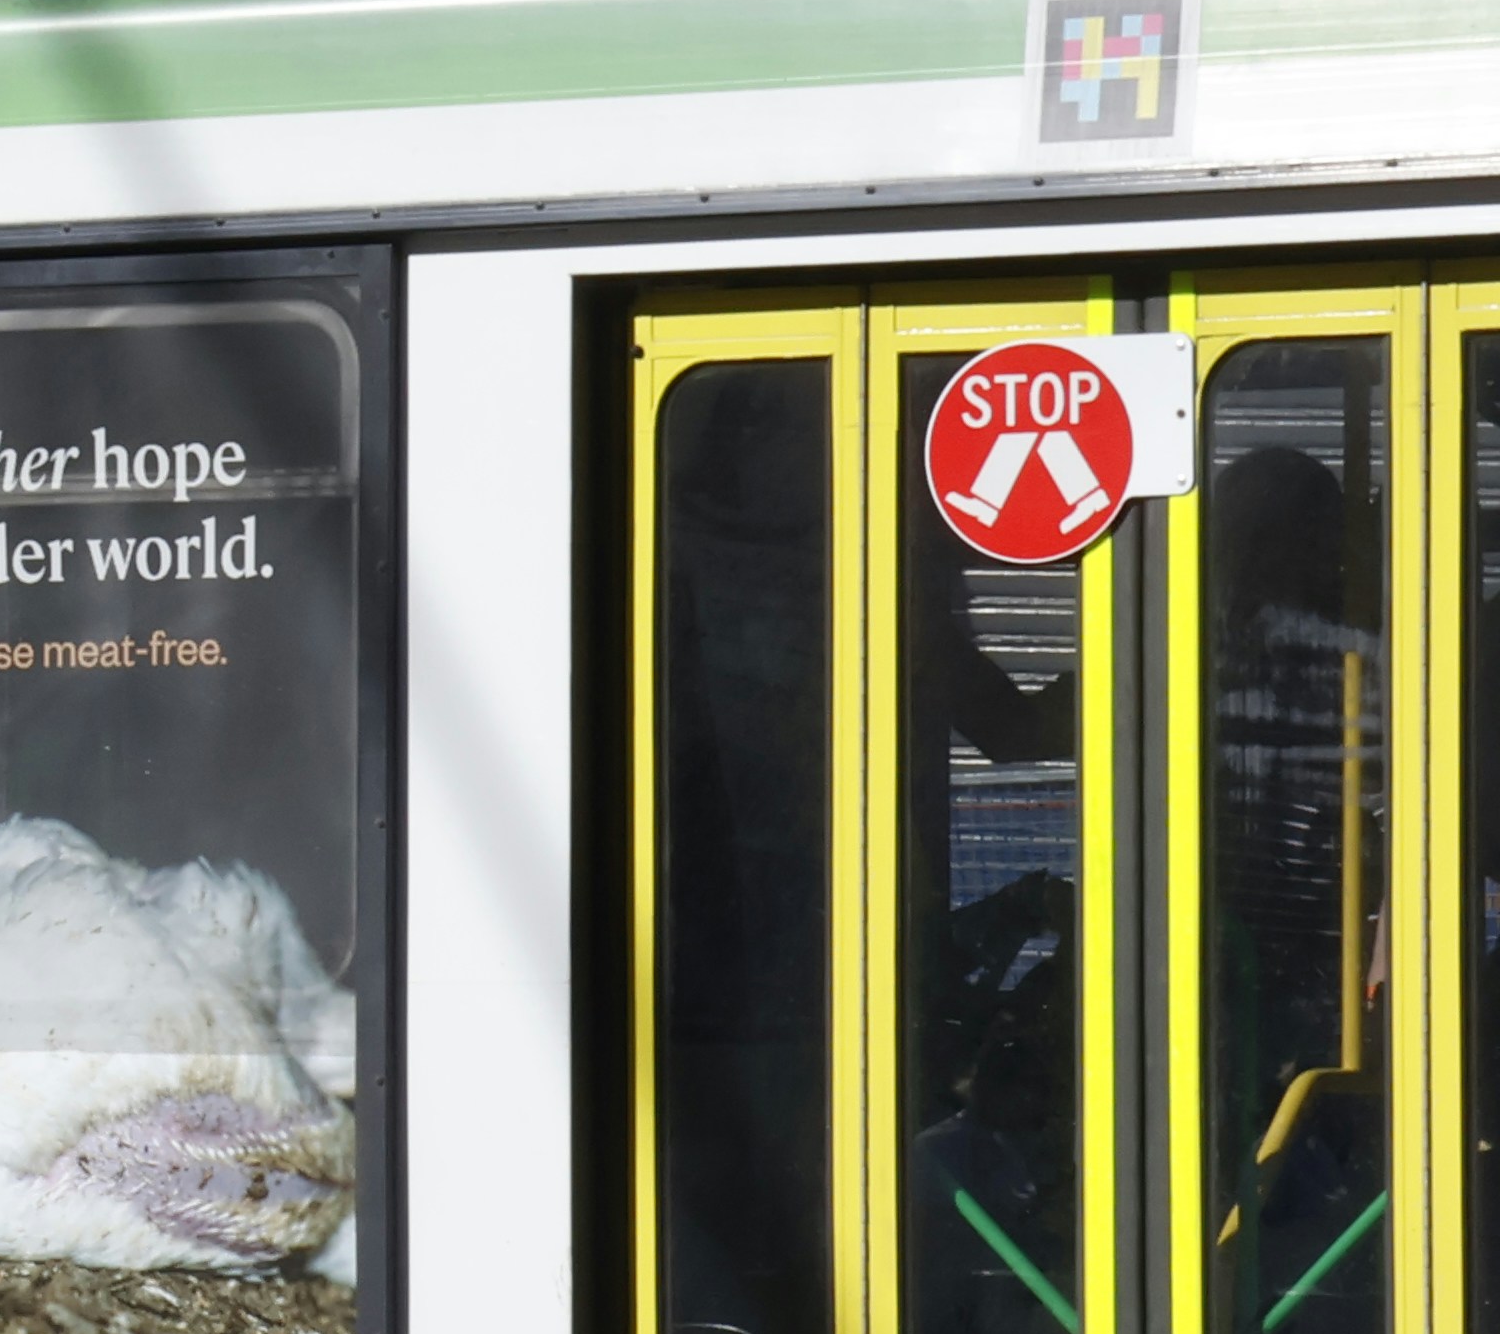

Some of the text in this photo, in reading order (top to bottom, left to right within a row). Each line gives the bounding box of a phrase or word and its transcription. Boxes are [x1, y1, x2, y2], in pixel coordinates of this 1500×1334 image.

[961, 371, 1101, 429] STOP
[91, 427, 246, 502] hope
[86, 515, 274, 582] world.
[42, 630, 228, 669] meat-free.
